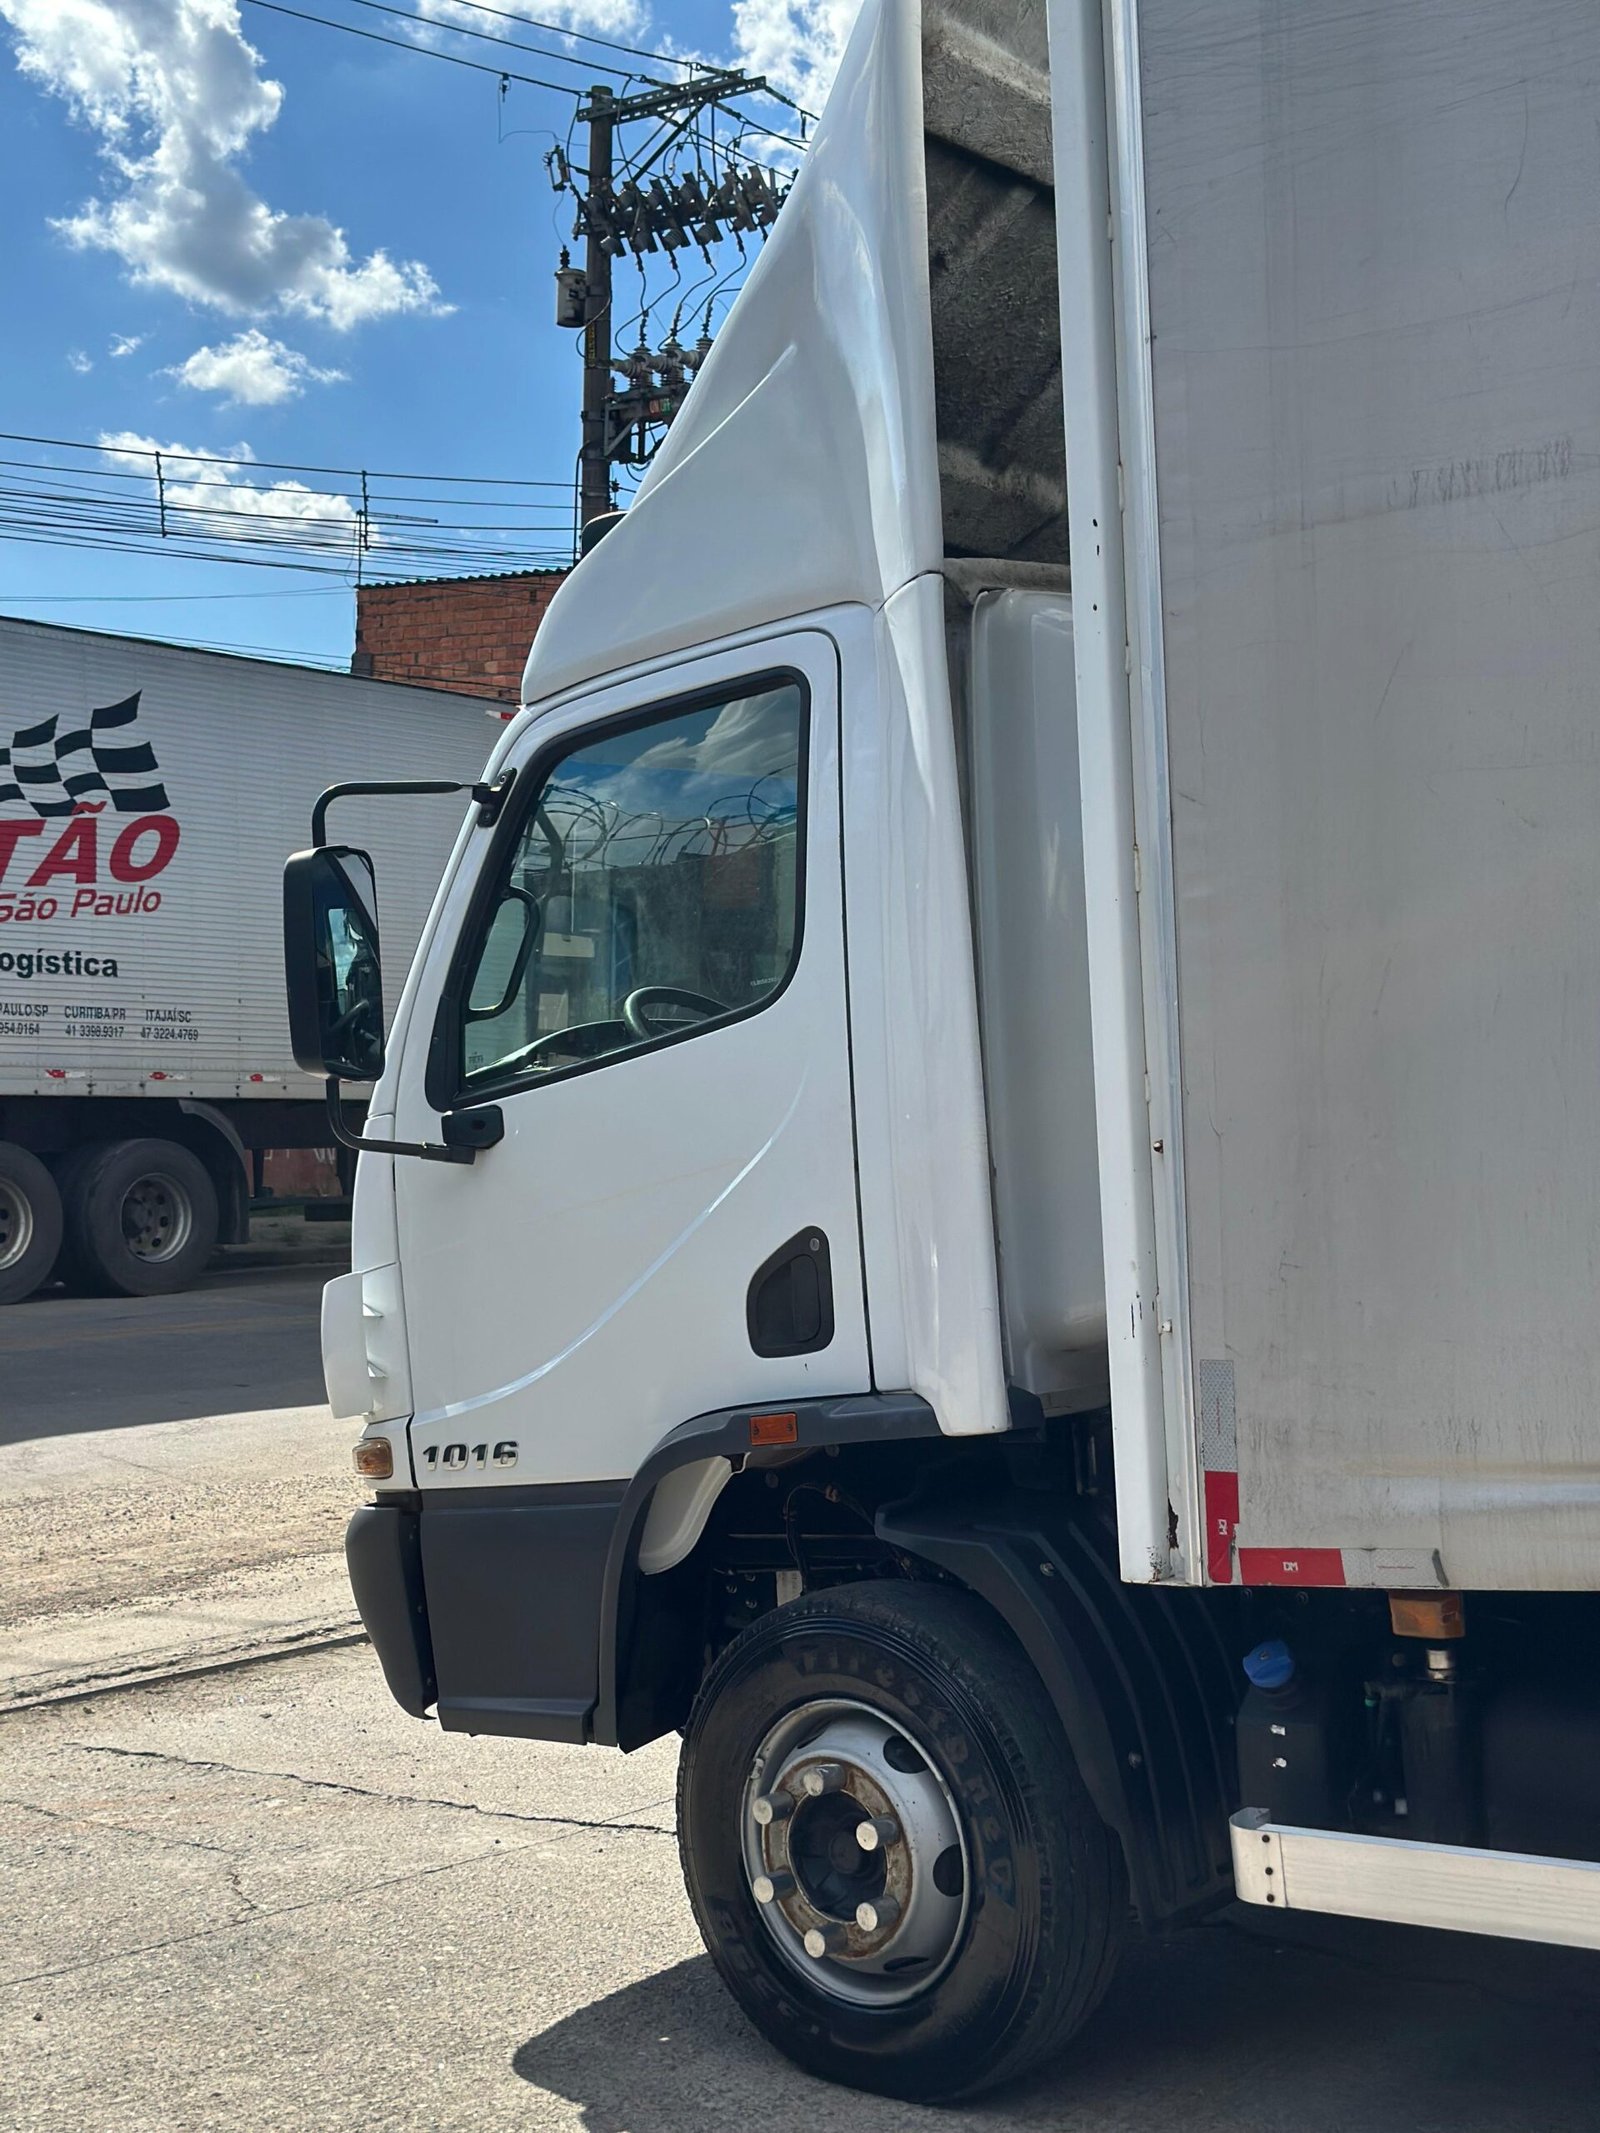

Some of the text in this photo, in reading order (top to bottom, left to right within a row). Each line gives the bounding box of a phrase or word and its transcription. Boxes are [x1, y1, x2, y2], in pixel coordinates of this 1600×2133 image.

[0, 886, 161, 922] São Paulo
[0, 948, 118, 978] ogística
[65, 1024, 76, 1036] 41
[422, 1441, 519, 1471] 1016
